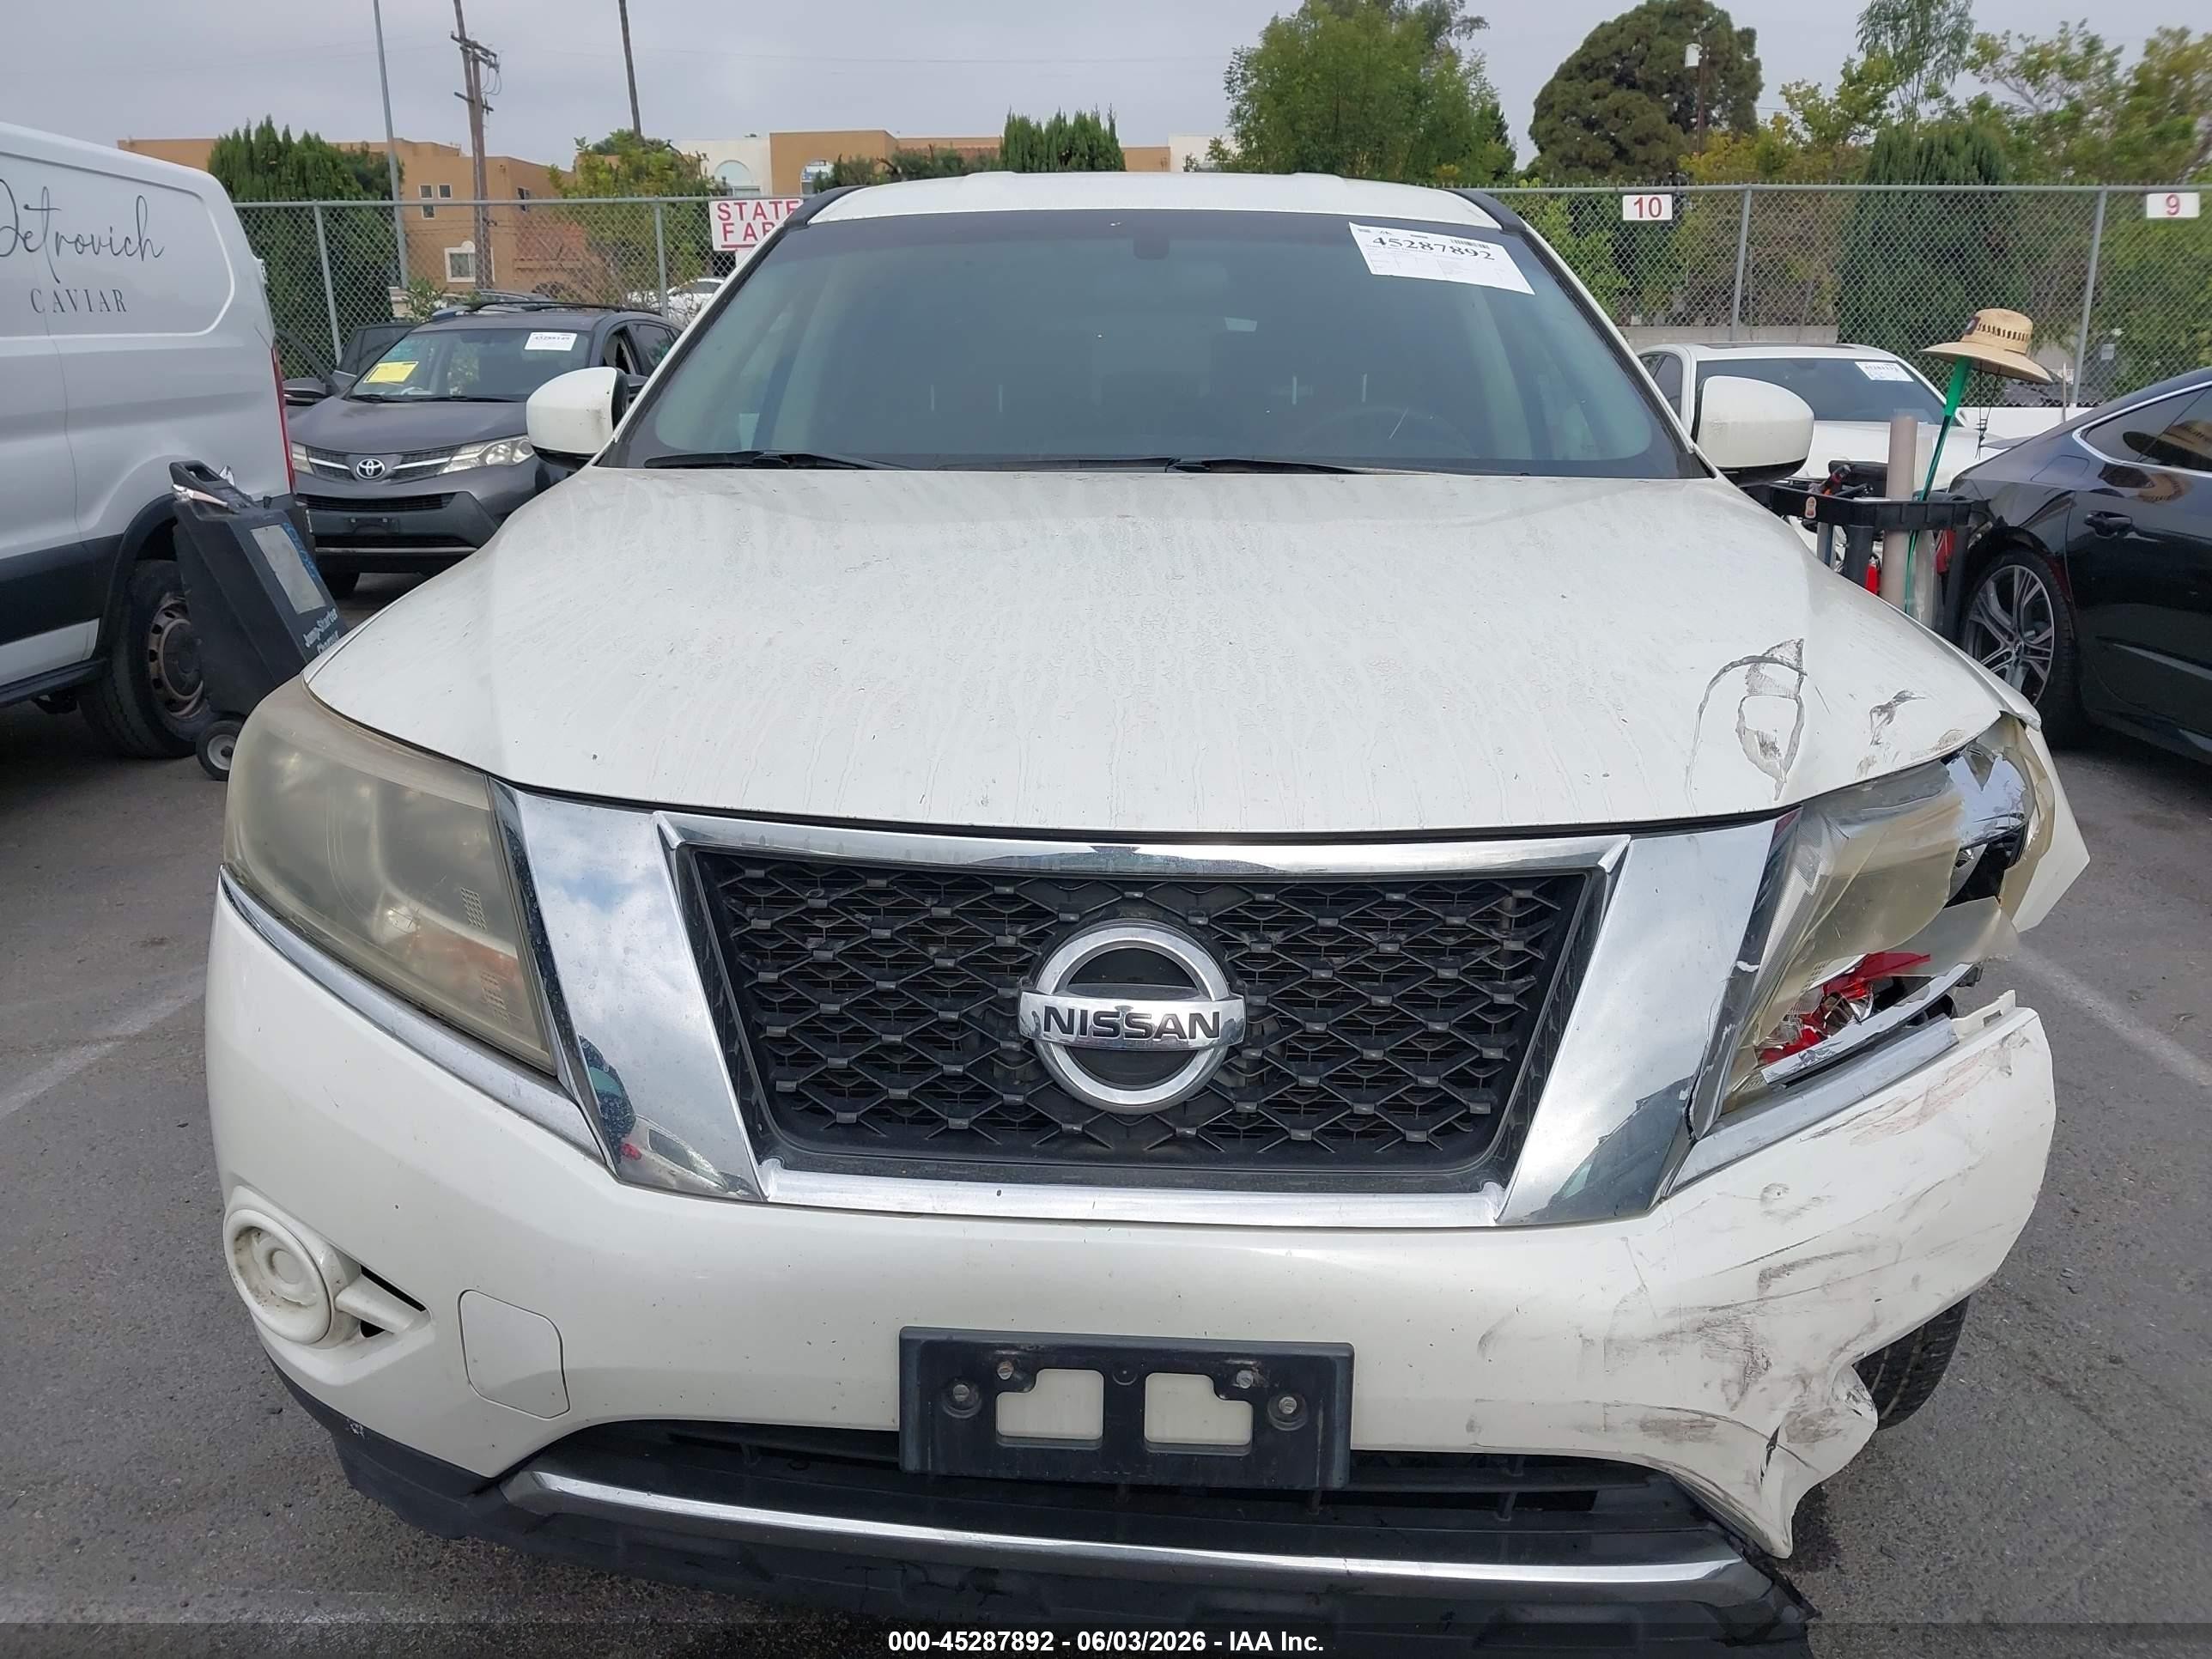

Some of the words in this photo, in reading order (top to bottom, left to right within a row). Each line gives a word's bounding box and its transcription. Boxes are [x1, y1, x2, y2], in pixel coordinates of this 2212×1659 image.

[1633, 196, 1662, 219] 10
[2165, 193, 2180, 216] 9
[1372, 235, 1497, 262] 45287892
[29, 288, 128, 314] CAVIAR
[1042, 1005, 1221, 1041] NISSAN
